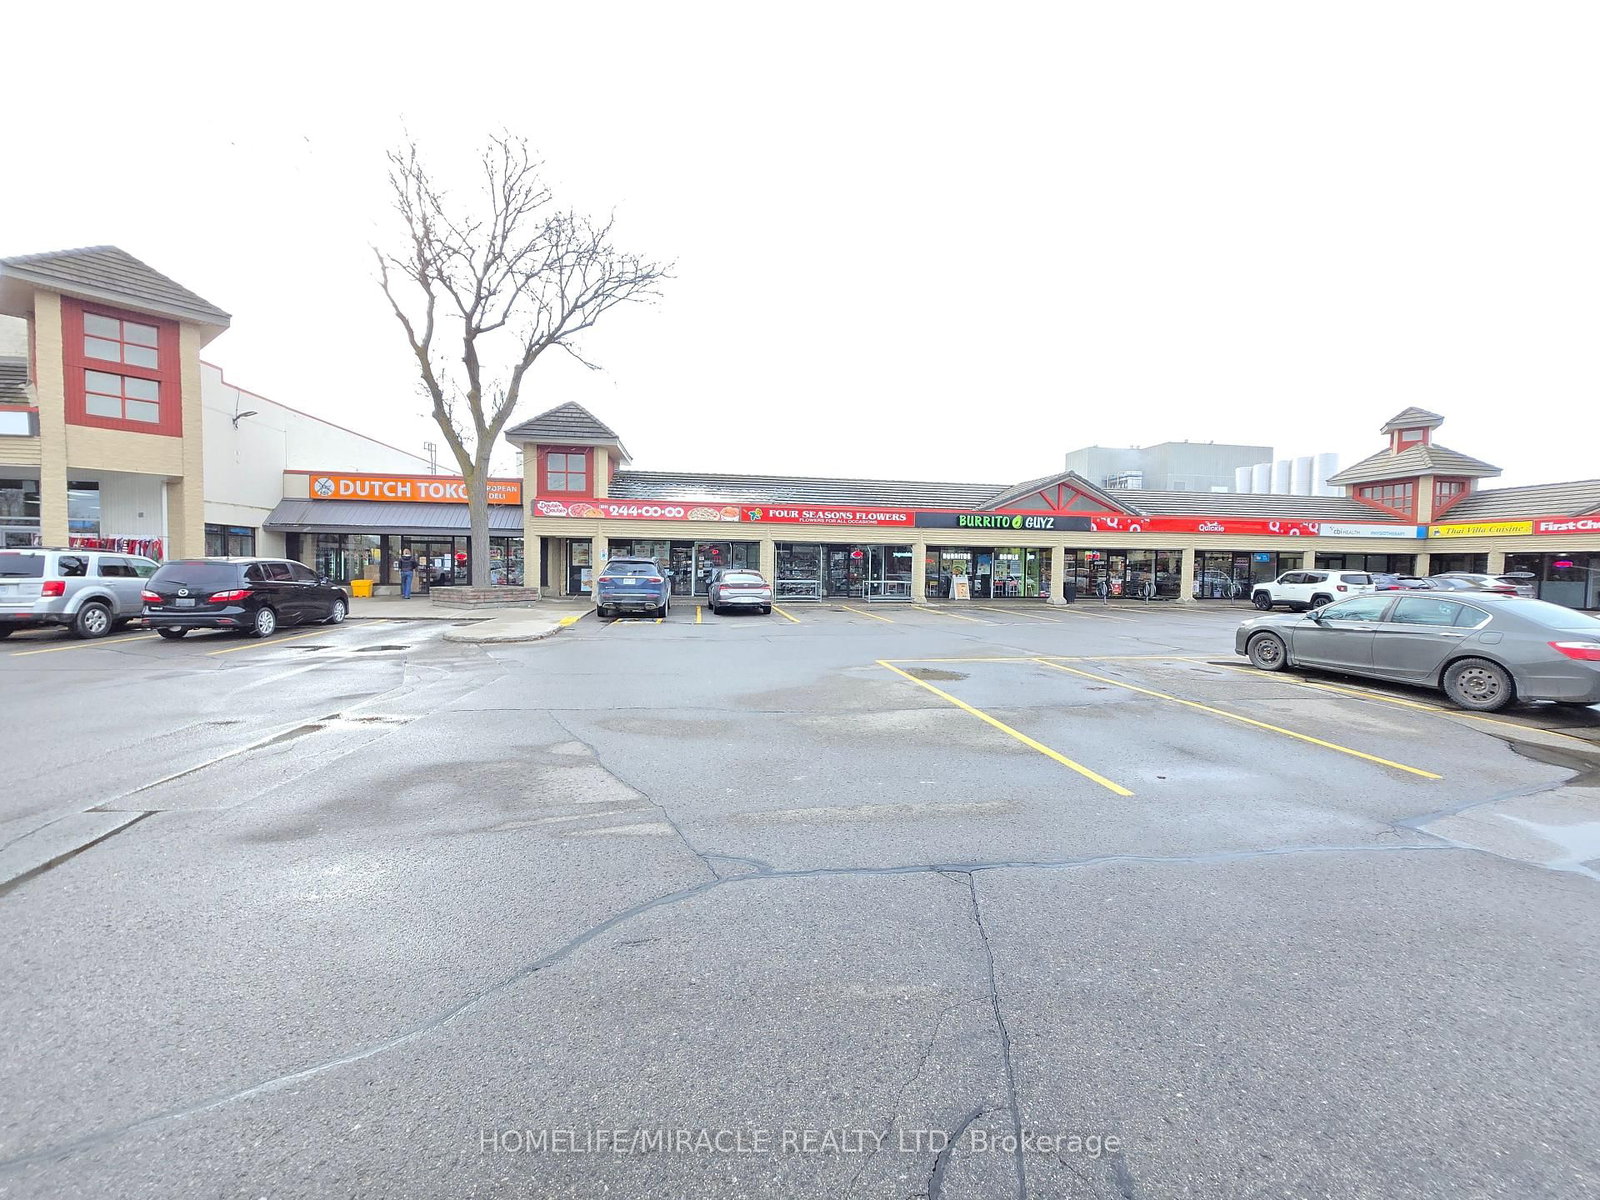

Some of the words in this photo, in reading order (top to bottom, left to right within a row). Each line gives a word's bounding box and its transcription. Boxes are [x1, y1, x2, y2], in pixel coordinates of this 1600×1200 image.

[340, 479, 411, 497] DUTCH
[769, 509, 799, 518] FOUR
[802, 511, 853, 519] SEASONS
[856, 512, 907, 521] FLOWERS
[959, 514, 1010, 528] BURRITO
[1025, 516, 1054, 528] GUYZ
[1540, 521, 1577, 531] First
[1198, 523, 1225, 532] Quickie
[1446, 527, 1465, 535] Thai
[1489, 525, 1524, 533] Cuisine
